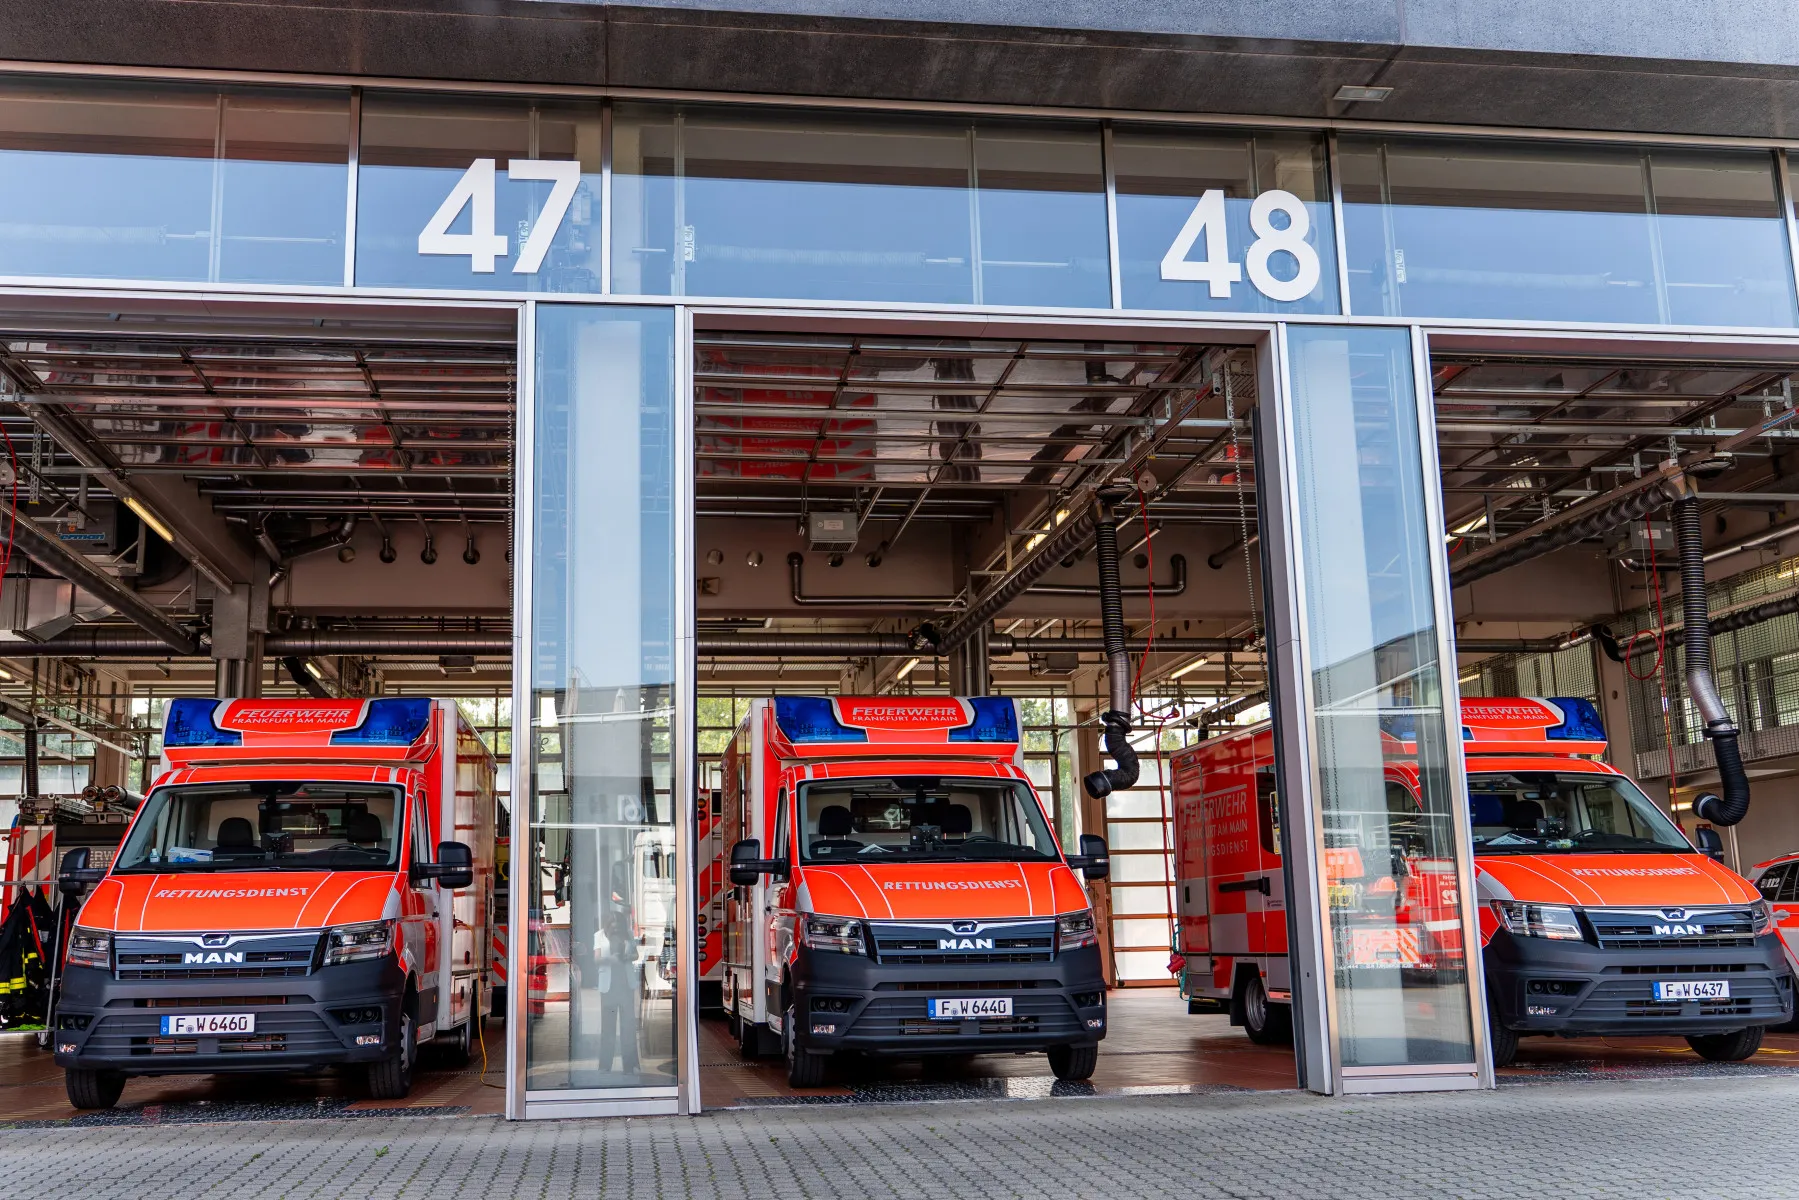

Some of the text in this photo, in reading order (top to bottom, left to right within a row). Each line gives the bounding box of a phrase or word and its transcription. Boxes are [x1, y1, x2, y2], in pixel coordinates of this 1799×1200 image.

[418, 158, 581, 274] 47
[1160, 189, 1321, 302] 48
[235, 708, 352, 718] FEUERWEHR
[852, 706, 957, 716] FEUERWEHR
[1461, 706, 1544, 715] EUERWEHR
[1183, 786, 1247, 826] FEUERWEHR
[1183, 819, 1248, 842] FRANKFURT AM MAIN
[1573, 867, 1700, 877] RETTUNGSDIENST
[883, 878, 1023, 891] RETTUNGSDIENST
[155, 886, 311, 900] RETTUNGSDIENST
[1653, 924, 1705, 936] MAN
[939, 937, 994, 951] MAN
[184, 951, 243, 964] MAN
[1665, 983, 1674, 997] F
[1682, 983, 1690, 997] W
[1693, 982, 1723, 996] 6437
[941, 1000, 950, 1015] F
[960, 1000, 968, 1015] W
[972, 999, 1006, 1014] 6440
[175, 1017, 186, 1032] F
[196, 1017, 206, 1032] W
[209, 1016, 248, 1032] 6460
